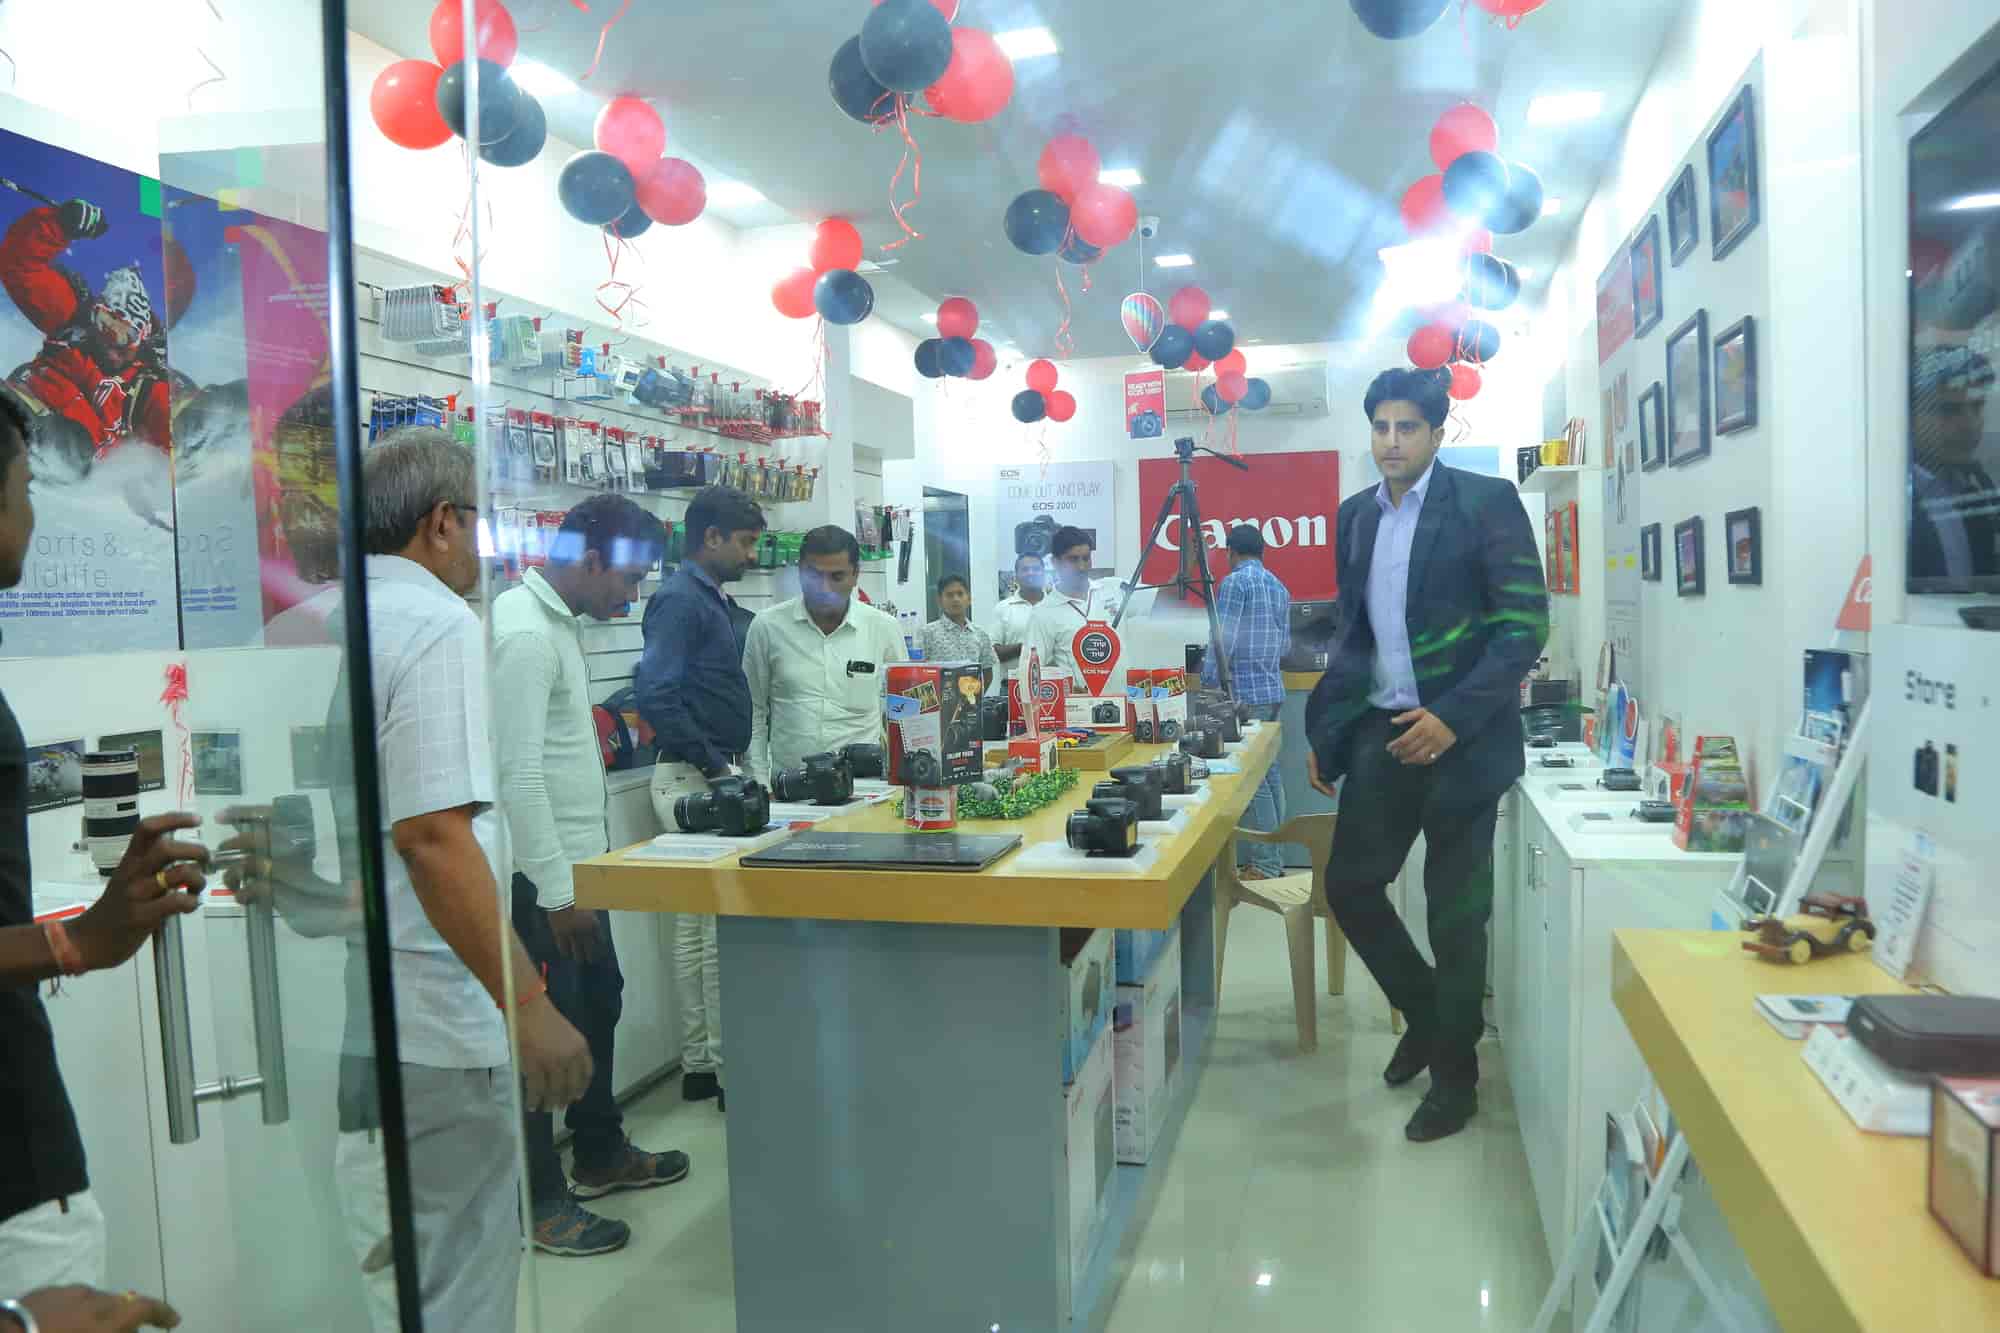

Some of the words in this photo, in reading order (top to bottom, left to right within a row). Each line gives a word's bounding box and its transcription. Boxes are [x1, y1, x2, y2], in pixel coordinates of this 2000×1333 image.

[1032, 502, 1054, 510] EOS
[1152, 514, 1327, 551] Caon
[1905, 669, 1956, 710] Store
